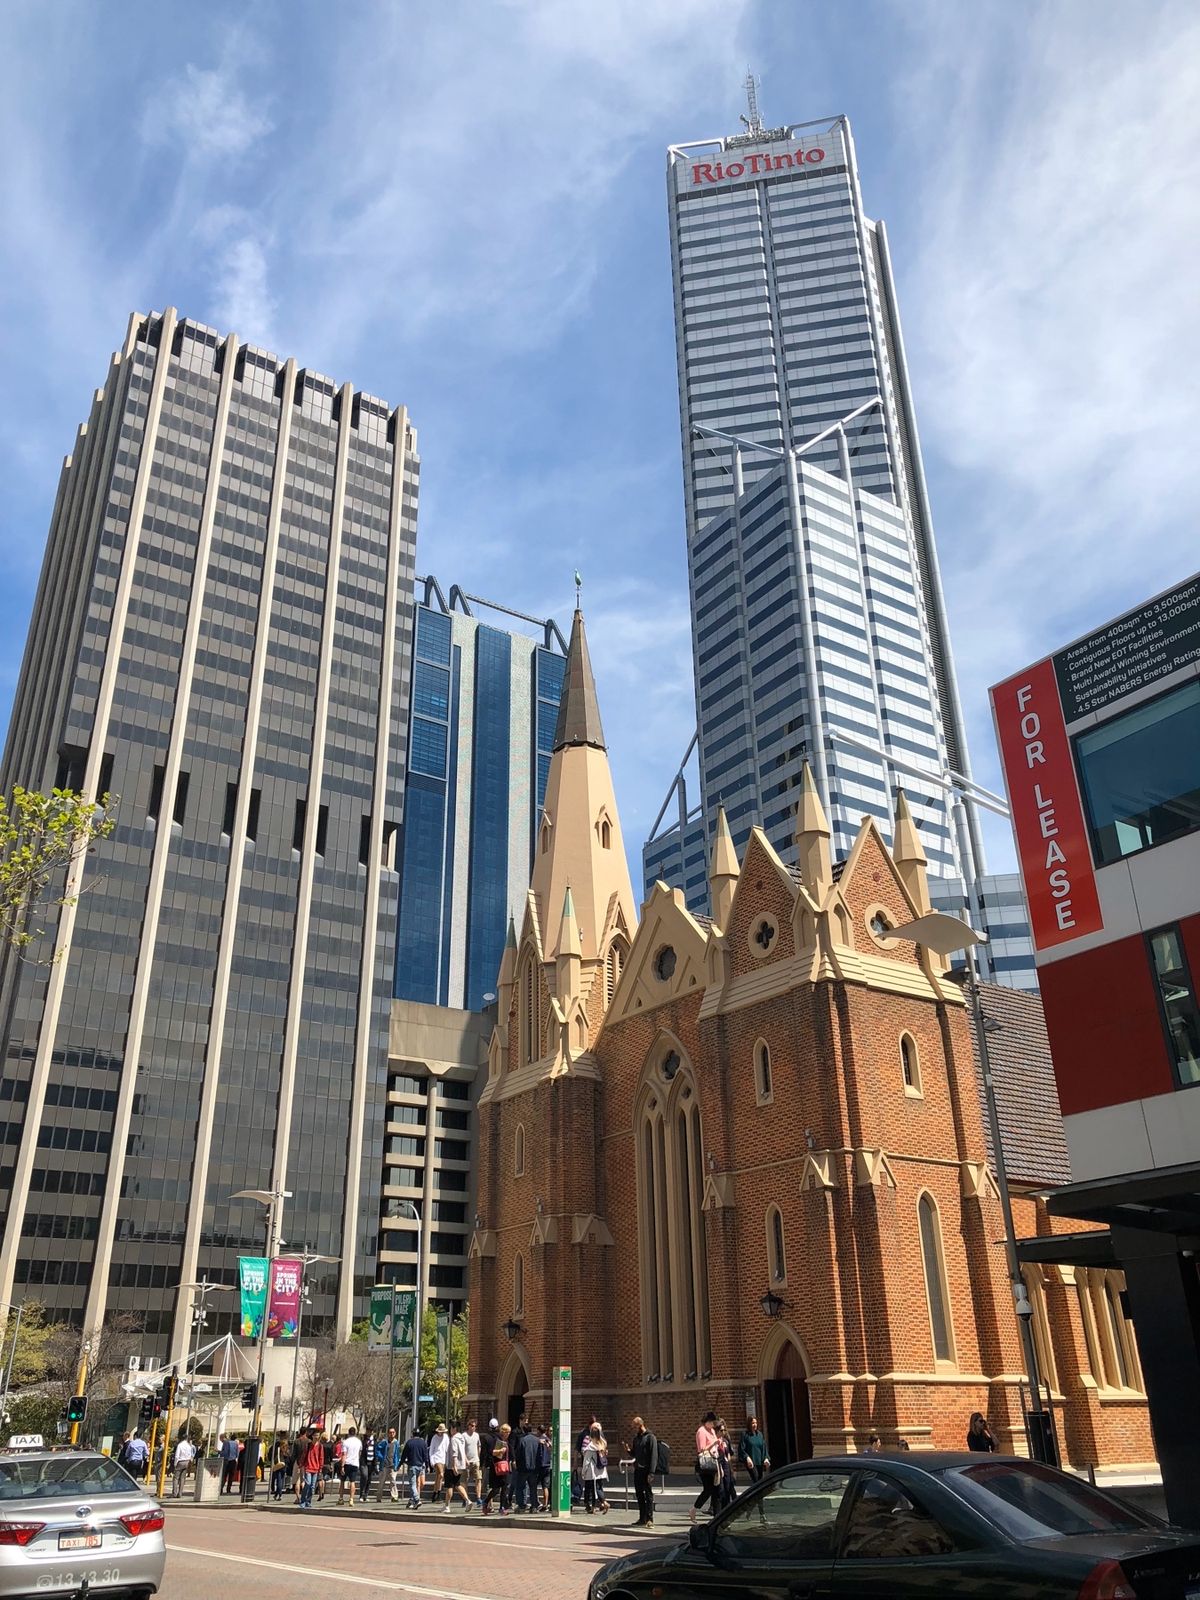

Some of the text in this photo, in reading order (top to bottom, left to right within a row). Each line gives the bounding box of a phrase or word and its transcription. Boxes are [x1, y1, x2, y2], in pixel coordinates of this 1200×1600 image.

[1067, 645, 1088, 660] Areas
[1088, 635, 1107, 648] from
[1144, 610, 1153, 618] to
[1069, 644, 1111, 671] Contiguous
[1111, 631, 1136, 648] Floors
[1136, 625, 1147, 635] up
[1148, 620, 1157, 629] to
[1071, 629, 1164, 682] Brand New EOT Facilities
[1073, 676, 1092, 692] Multi
[1093, 664, 1117, 682] Award
[1117, 649, 1149, 669] Winning
[1075, 652, 1167, 703] Sustainability Initiatives
[1078, 648, 1200, 713] 4.5 Star NABERS Energy Rating
[1016, 684, 1076, 931] FOR LEASE
[242, 1283, 264, 1291] CITY
[276, 1285, 296, 1293] CITY
[371, 1291, 392, 1301] PURPOSE
[14, 1436, 40, 1444] TAXI
[61, 1539, 80, 1548] TAXI
[56, 1573, 74, 1587] 13
[102, 1568, 120, 1583] 30
